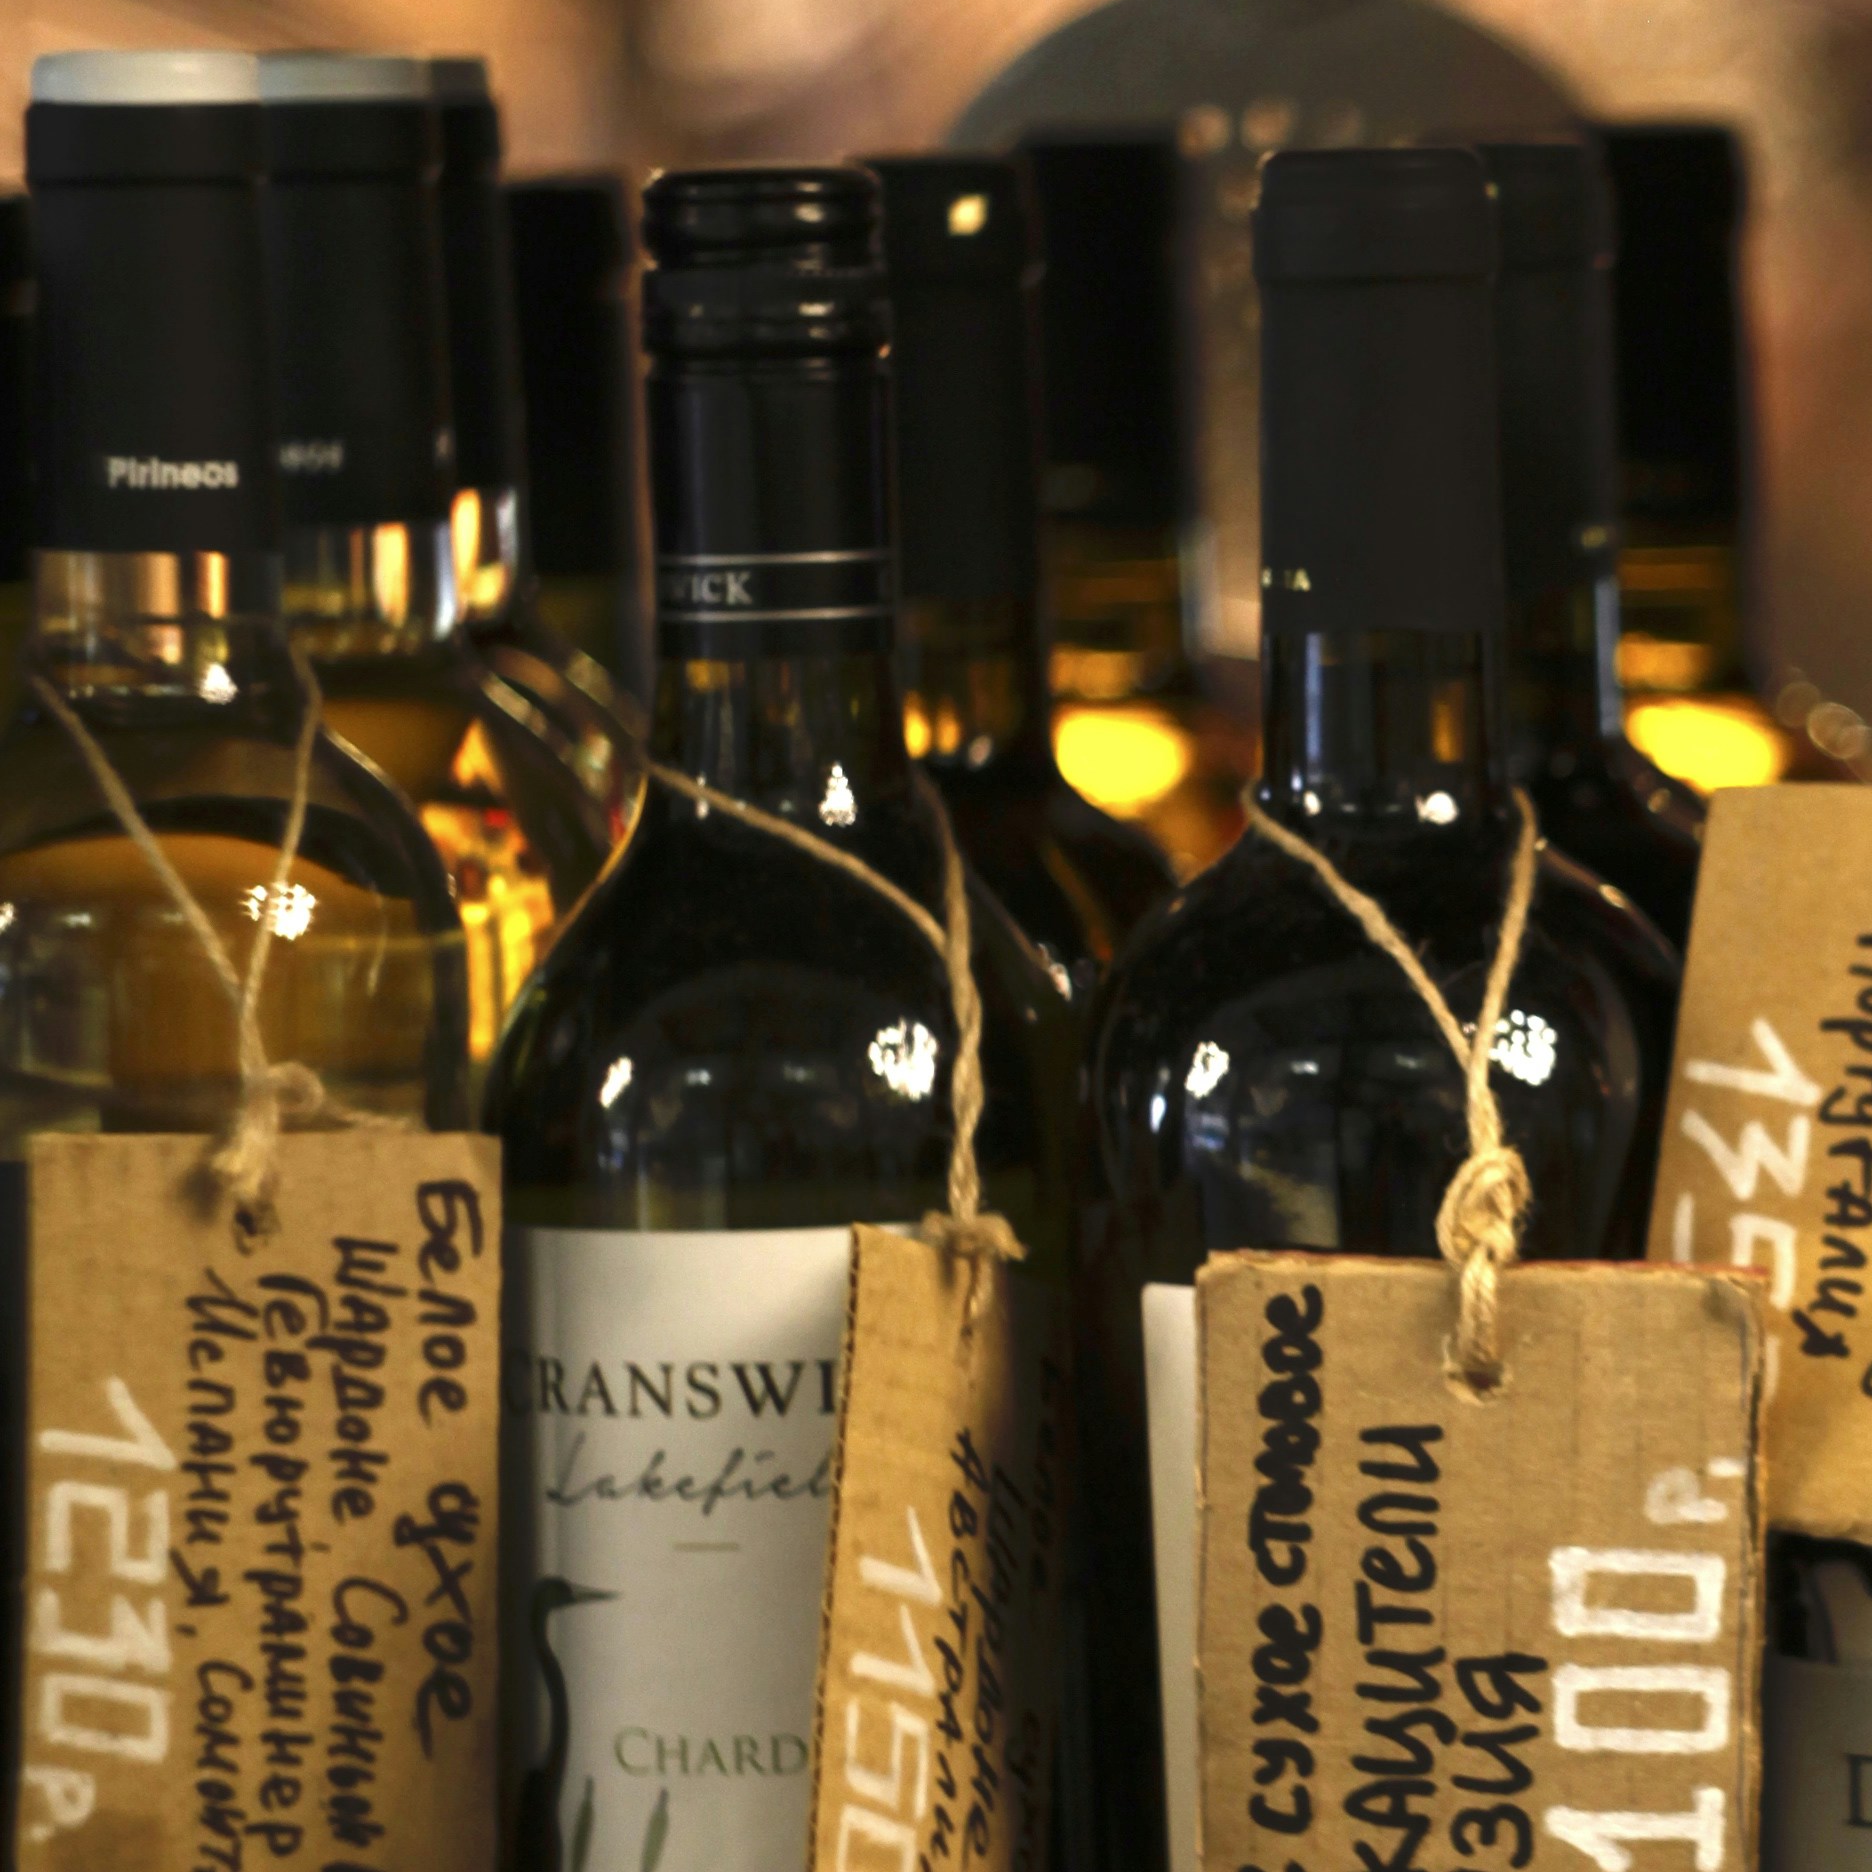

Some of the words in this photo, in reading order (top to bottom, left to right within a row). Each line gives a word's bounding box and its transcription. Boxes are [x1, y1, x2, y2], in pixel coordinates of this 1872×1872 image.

[105, 454, 240, 491] Pirineos
[416, 1178, 484, 1429] Белое
[1674, 1016, 1824, 1408] 135
[38, 1376, 178, 1764] 1230
[394, 1478, 478, 1760] сухое
[613, 1726, 810, 1777] CHARD
[1248, 1603, 1325, 1838] сухое
